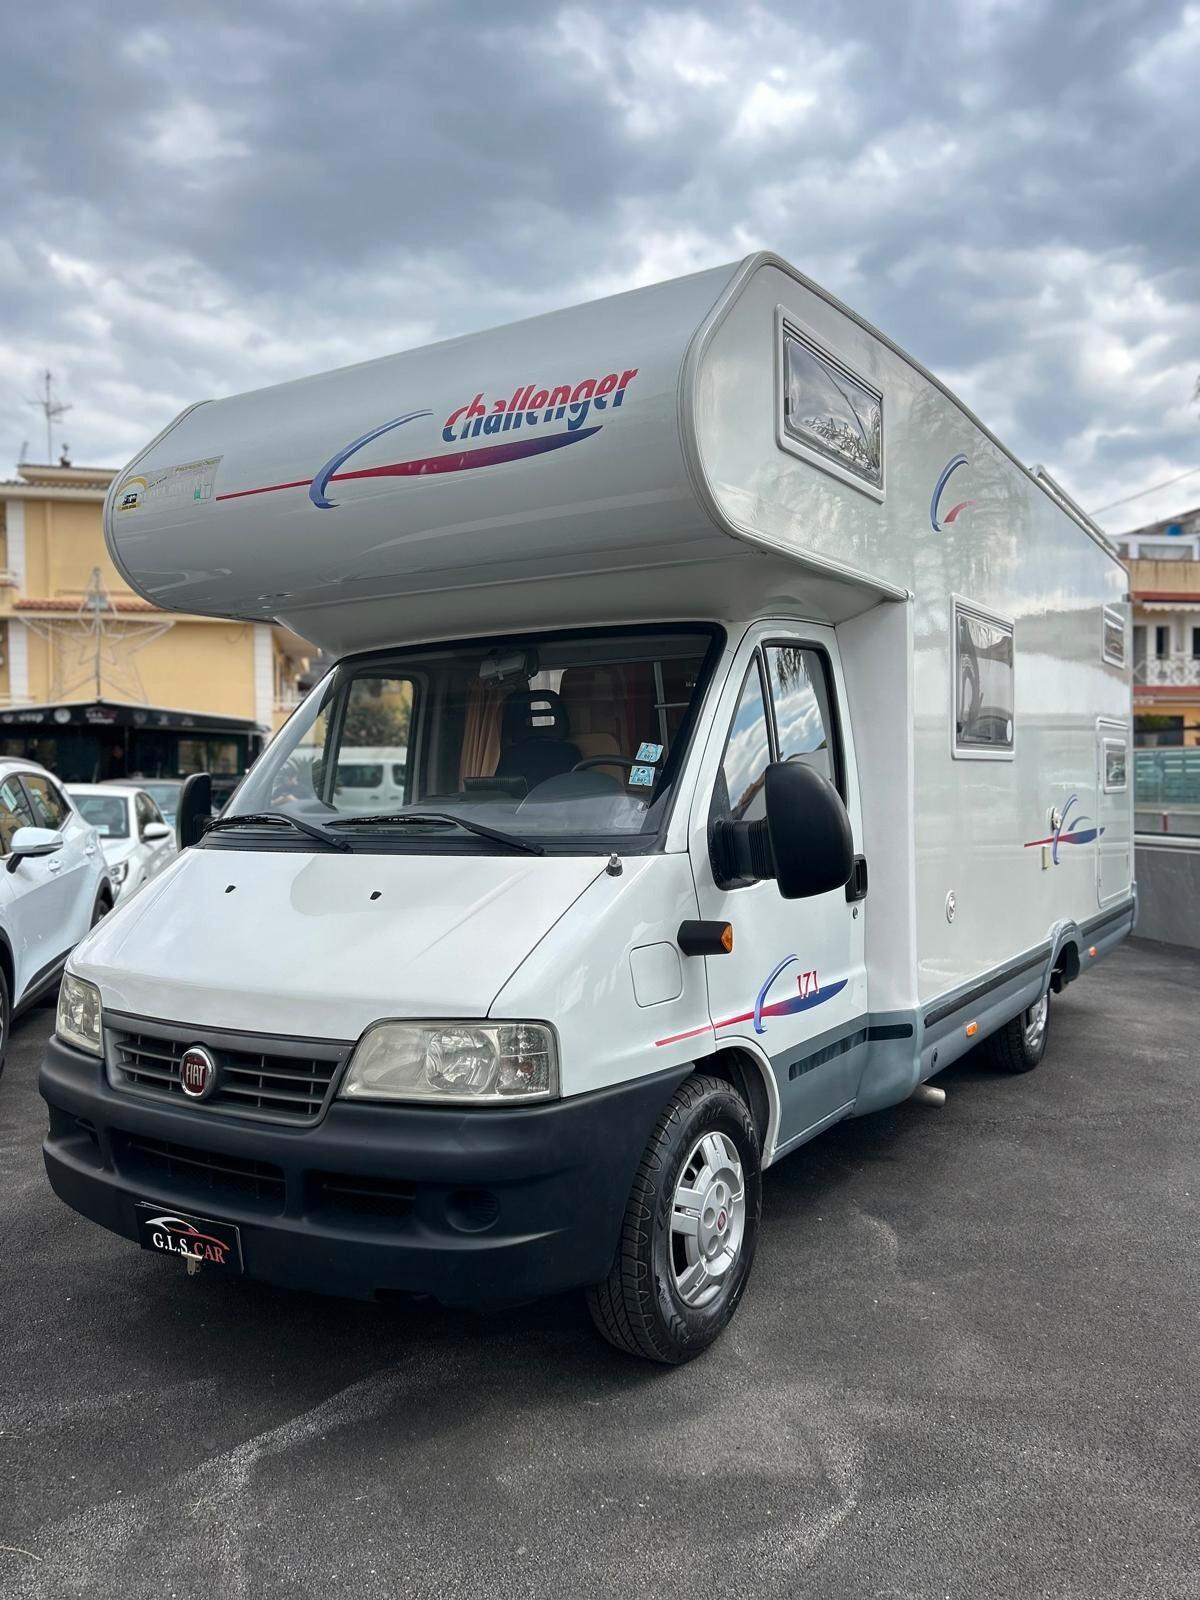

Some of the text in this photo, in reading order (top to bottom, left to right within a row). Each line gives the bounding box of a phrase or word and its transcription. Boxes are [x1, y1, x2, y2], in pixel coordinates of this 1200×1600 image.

[442, 368, 639, 442] Challenger
[797, 970, 819, 999] 171
[186, 1063, 205, 1086] FIAT
[152, 1232, 226, 1264] G.L.S. CAR
